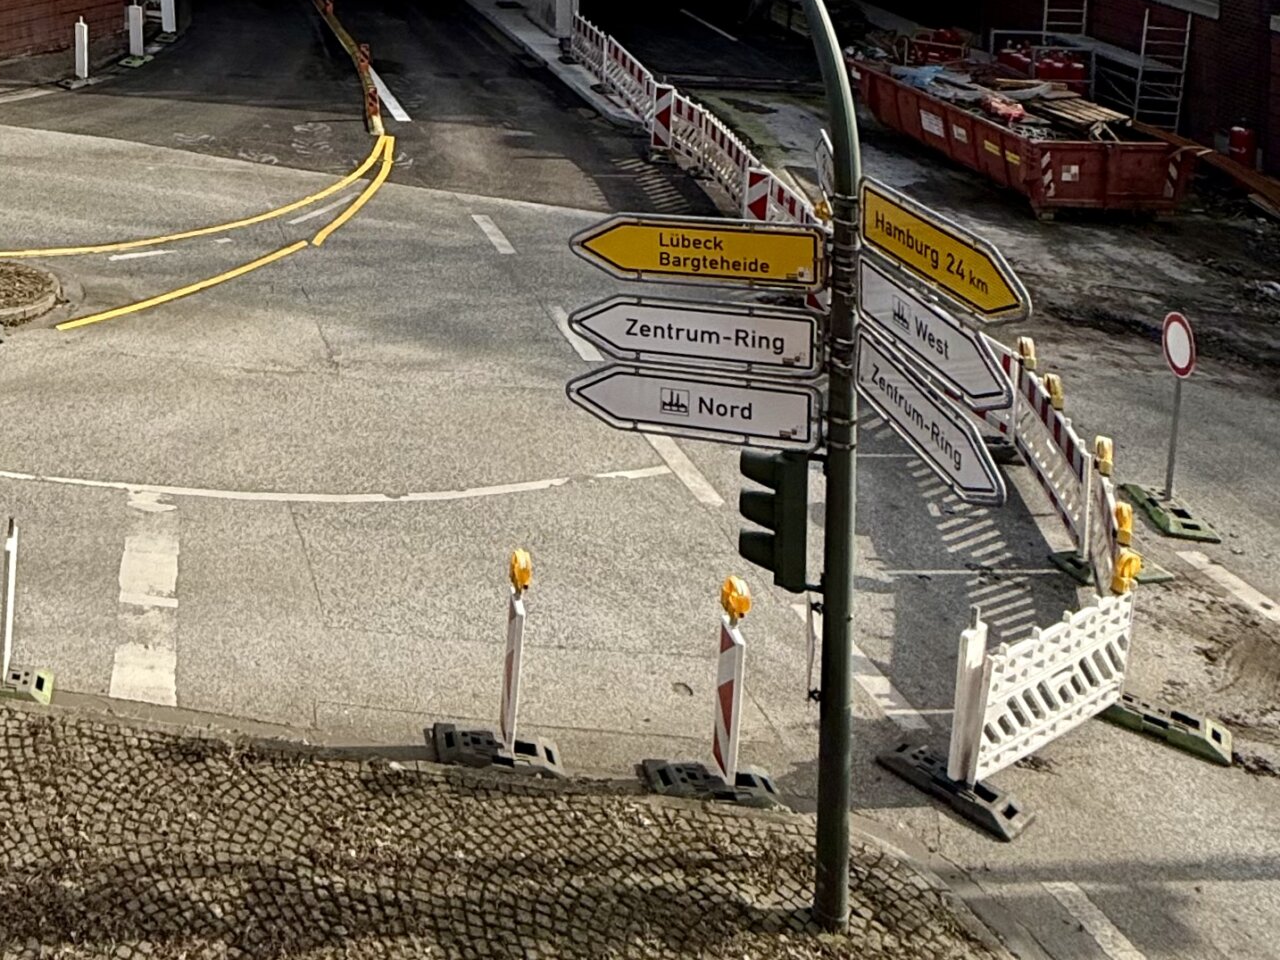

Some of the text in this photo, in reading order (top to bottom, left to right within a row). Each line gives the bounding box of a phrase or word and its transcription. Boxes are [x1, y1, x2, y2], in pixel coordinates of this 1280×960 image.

[659, 232, 724, 251] Lübeck
[875, 210, 988, 294] Hamburg 24 km
[659, 251, 770, 273] Bargteheide
[625, 317, 785, 355] Zentrum-Ring
[914, 316, 949, 360] West
[698, 396, 753, 420] Nord
[871, 363, 962, 471] Zentrum-Ring
